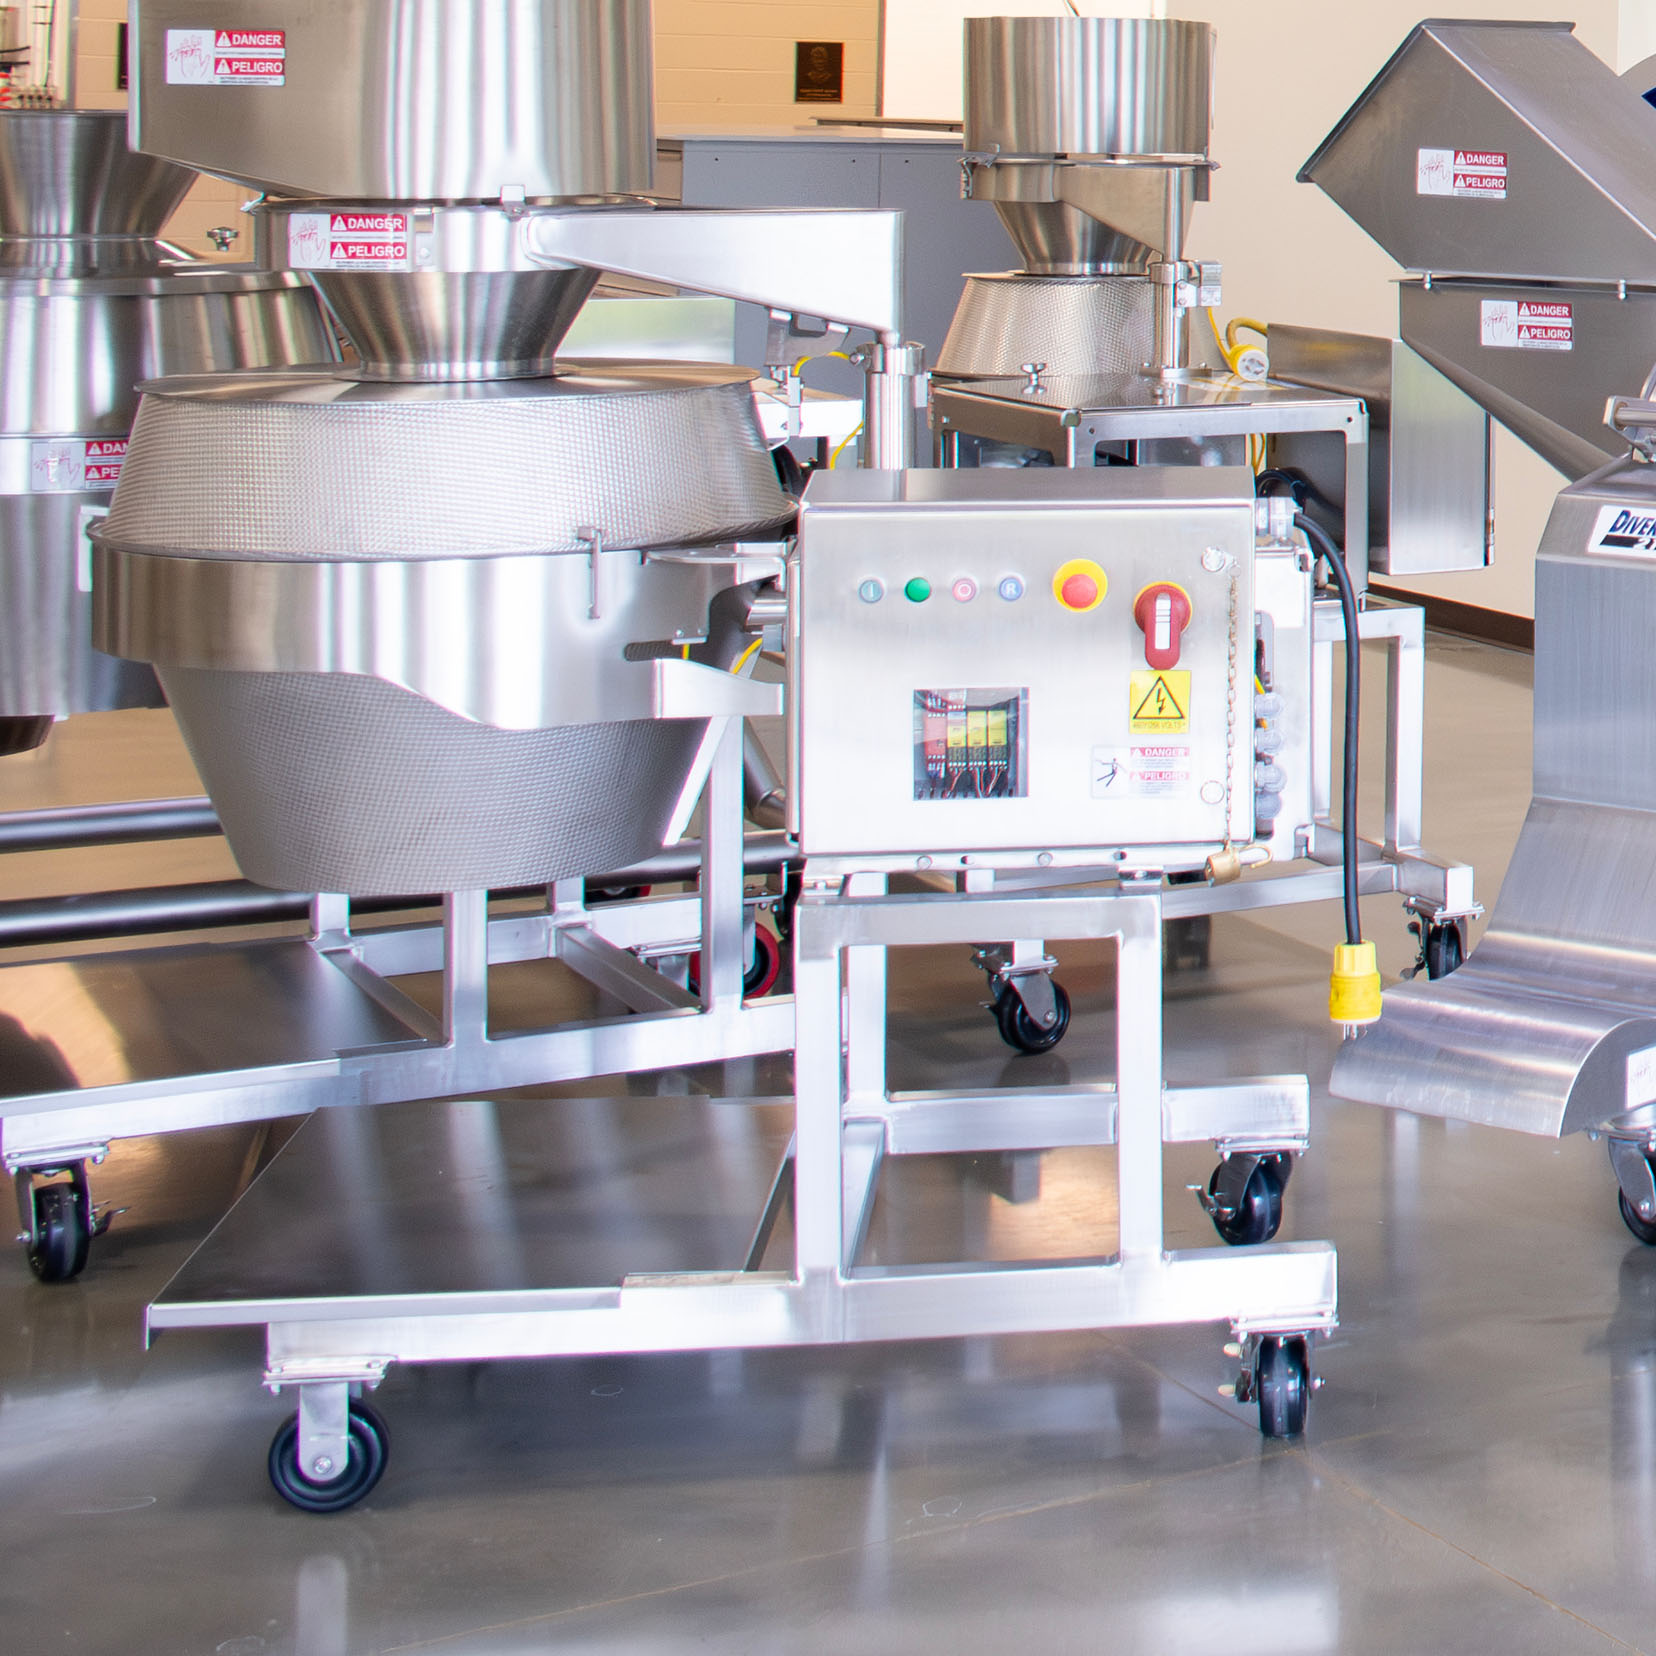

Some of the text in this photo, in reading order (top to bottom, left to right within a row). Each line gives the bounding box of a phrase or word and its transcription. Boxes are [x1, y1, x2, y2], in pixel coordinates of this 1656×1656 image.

[232, 34, 282, 46] DANGER
[232, 62, 283, 73] PELIGRO
[1466, 153, 1505, 165] DANGER
[1466, 177, 1505, 189] PELIGRO
[347, 217, 402, 230] DANGER
[347, 246, 405, 258] PELIGRO
[1530, 304, 1569, 317] DANGER
[1530, 327, 1571, 340] PELIGRO
